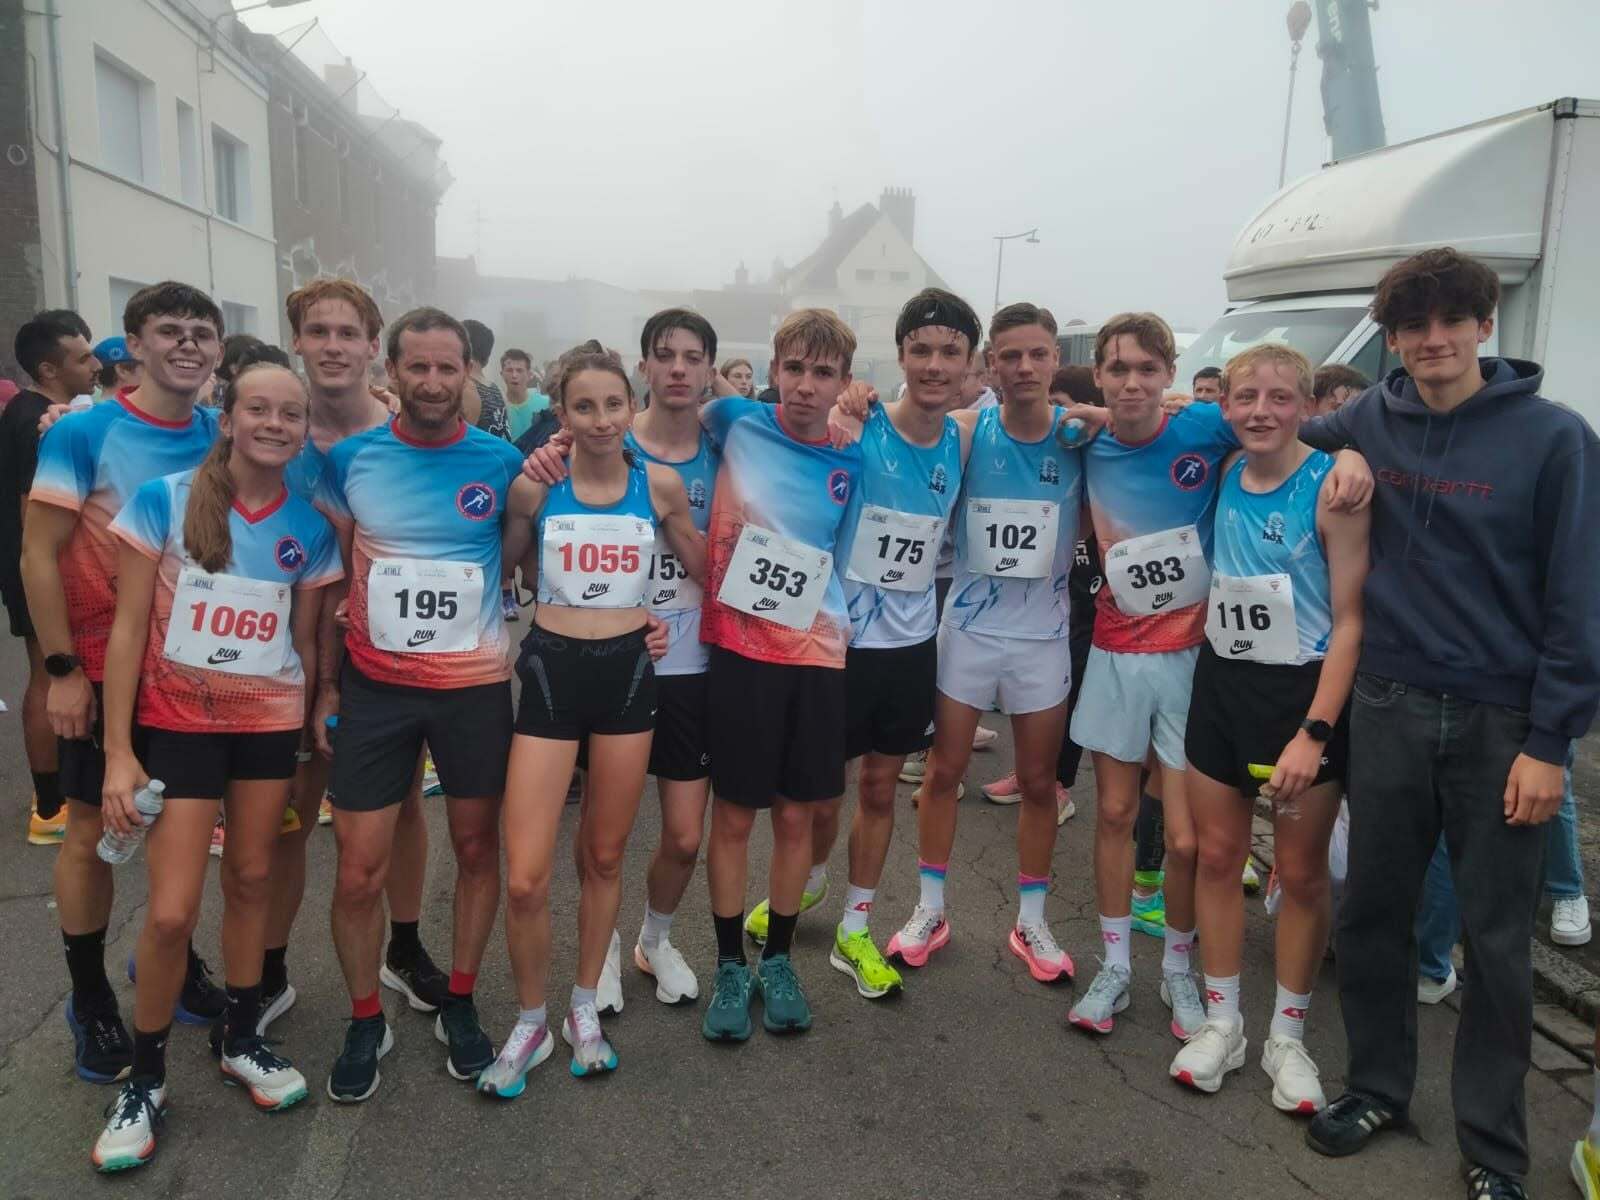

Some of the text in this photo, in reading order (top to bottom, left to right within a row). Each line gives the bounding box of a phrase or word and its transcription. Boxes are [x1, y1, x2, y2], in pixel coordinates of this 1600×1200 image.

[985, 523, 1037, 550] 102
[877, 534, 926, 565] 175
[558, 542, 640, 574] 1055
[1000, 557, 1020, 566] RUN
[749, 557, 808, 598] 353
[886, 569, 905, 580] RUN
[1127, 556, 1186, 589] 383
[588, 583, 611, 592] RUN
[658, 588, 678, 598] RUN
[759, 597, 781, 609] RUN
[1154, 592, 1174, 602] RUN
[394, 588, 458, 620] 195
[190, 601, 279, 643] 1069
[1217, 602, 1271, 631] 116
[413, 629, 437, 640] RUN
[1233, 640, 1254, 649] RUN
[215, 647, 242, 659] RUN
